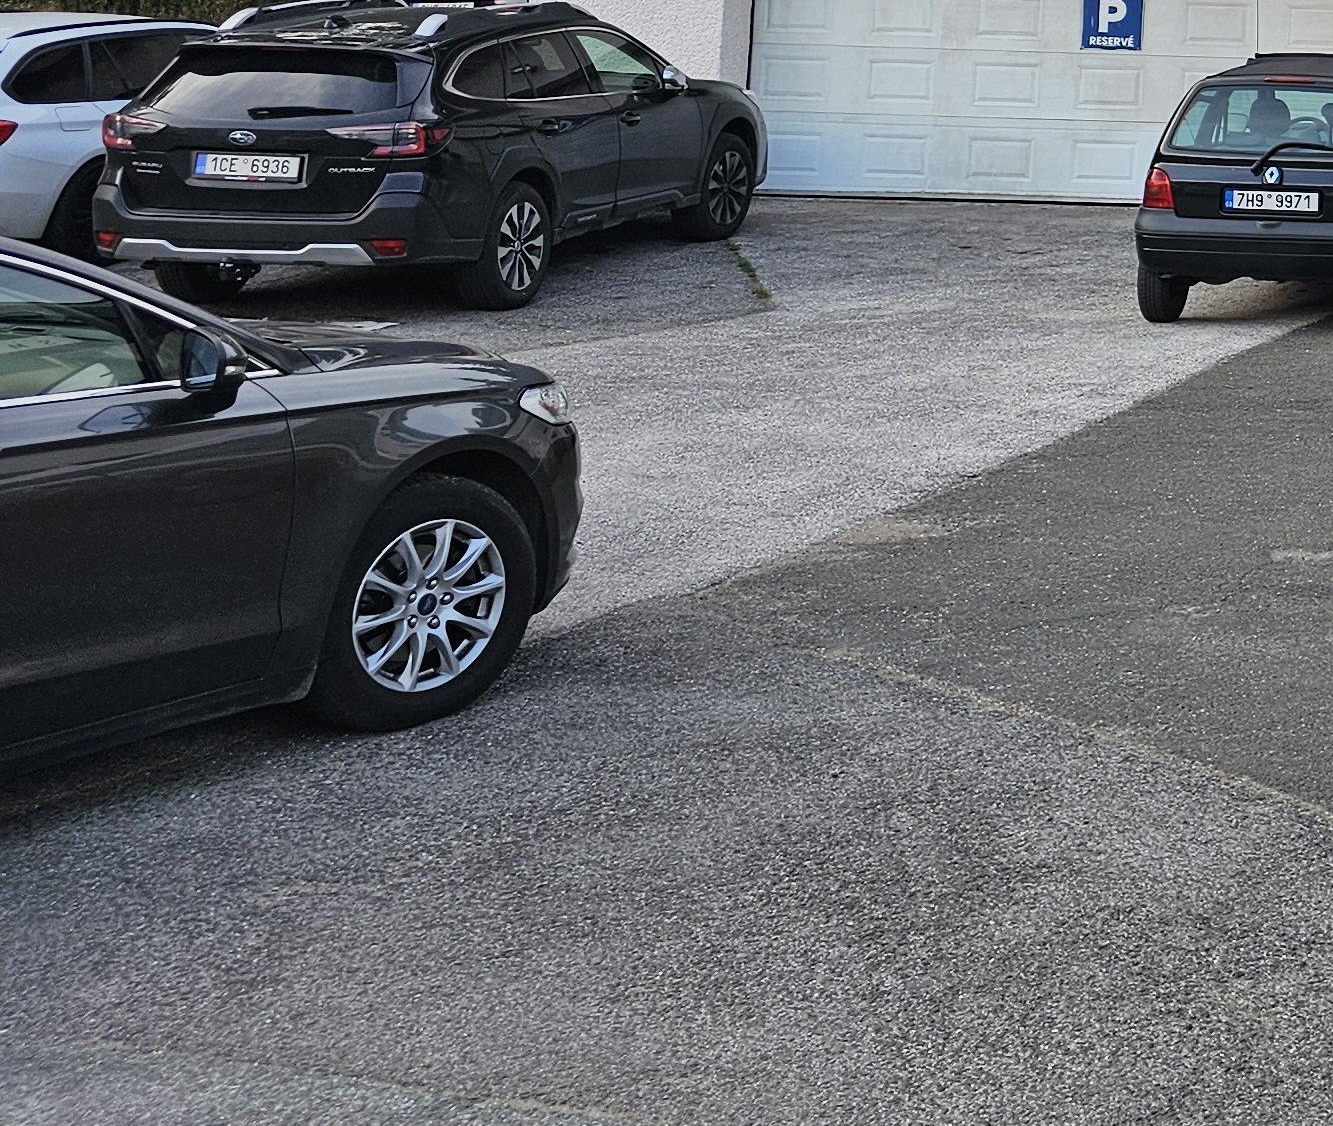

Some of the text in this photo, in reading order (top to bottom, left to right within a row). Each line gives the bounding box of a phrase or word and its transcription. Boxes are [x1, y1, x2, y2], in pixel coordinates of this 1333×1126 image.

[1088, 34, 1135, 48] RESERVÉ
[211, 157, 290, 174] 1CE 6936
[1237, 193, 1264, 207] 7H9
[1275, 194, 1310, 209] 9971
